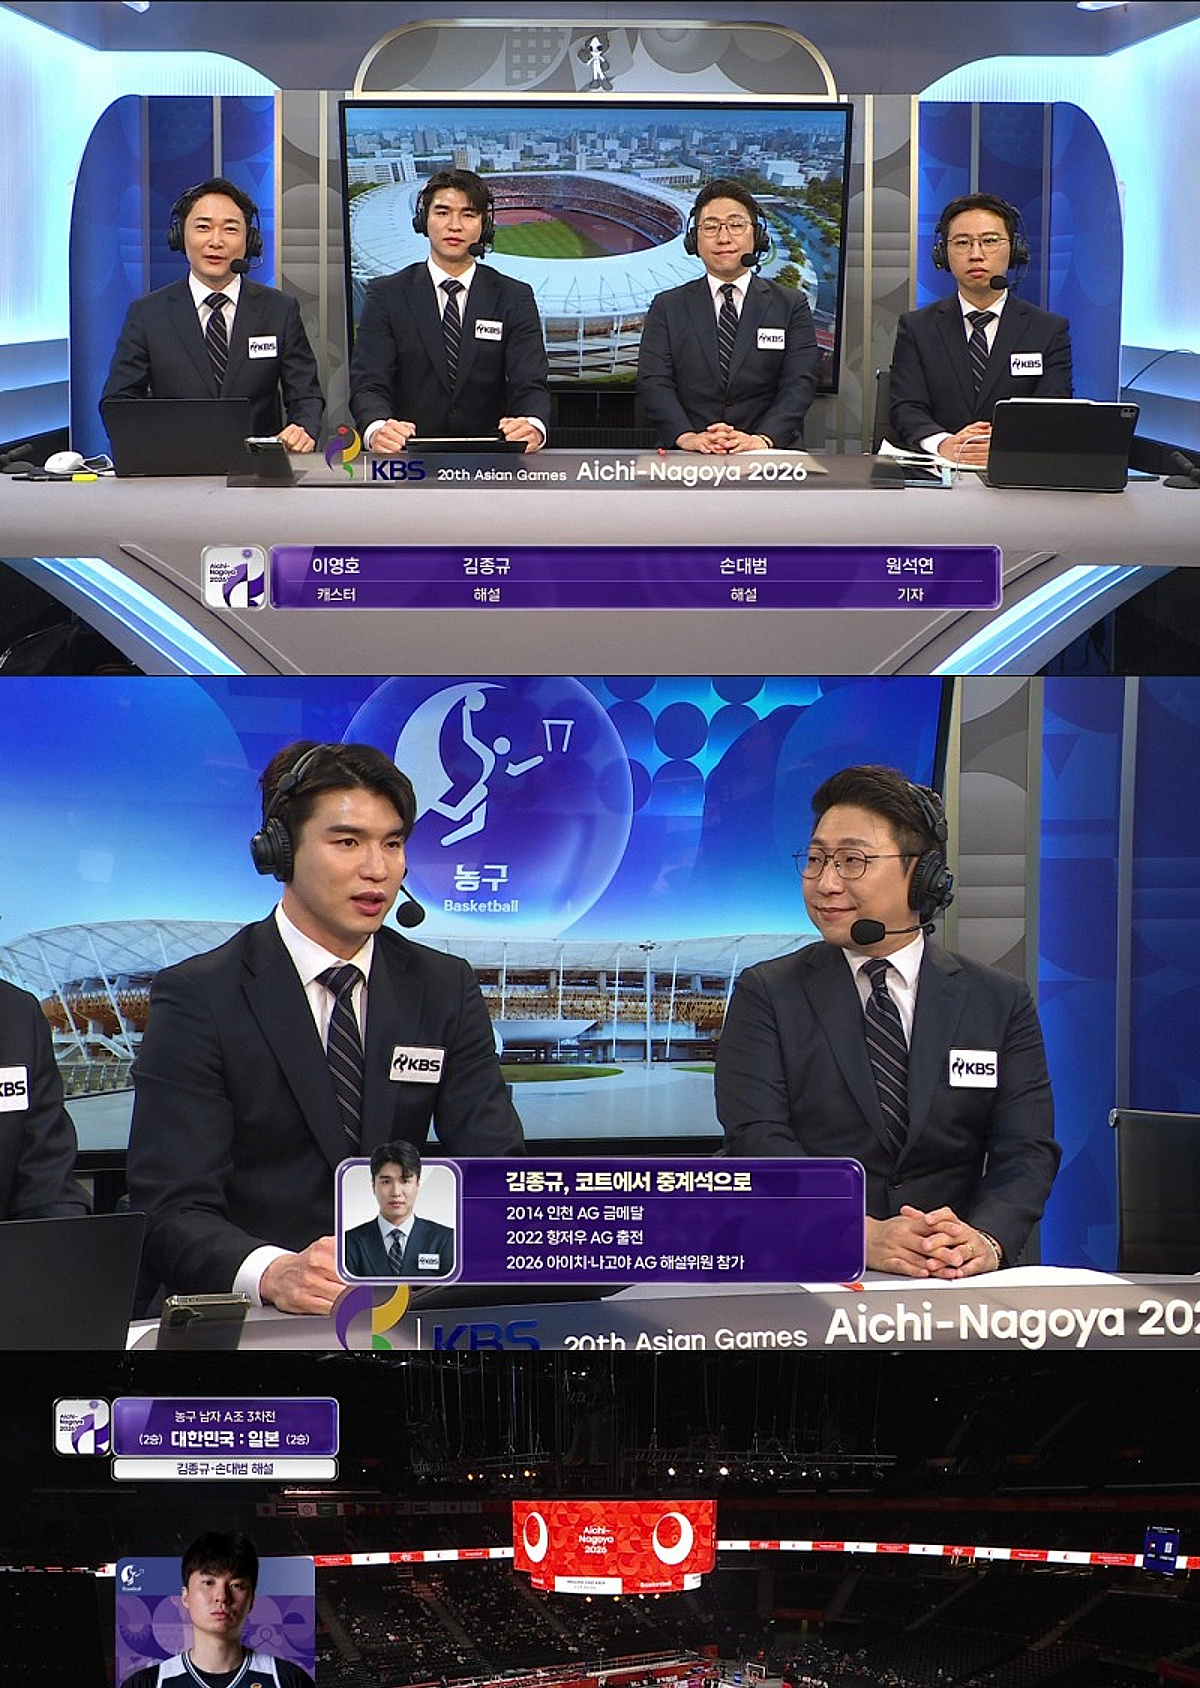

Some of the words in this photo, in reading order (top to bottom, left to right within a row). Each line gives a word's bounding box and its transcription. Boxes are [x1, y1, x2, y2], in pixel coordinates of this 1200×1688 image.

[371, 460, 427, 481] KBS
[437, 468, 471, 481] 20th
[474, 468, 512, 481] Asian
[516, 468, 567, 481] Games
[576, 461, 741, 486] Aichi-Nagoya
[747, 461, 807, 481] 2026
[453, 863, 510, 892] 농구
[443, 899, 519, 913] Basketball
[407, 1058, 442, 1072] KBS
[965, 1062, 997, 1076] KBS
[433, 1320, 540, 1350] KBS
[563, 1333, 626, 1350] 20th
[636, 1328, 706, 1350] Asian
[715, 1327, 808, 1349] Games
[824, 1300, 1126, 1350] Aichi-Nagoya
[578, 1534, 614, 1545] Nagoya
[584, 1545, 607, 1554] 2026
